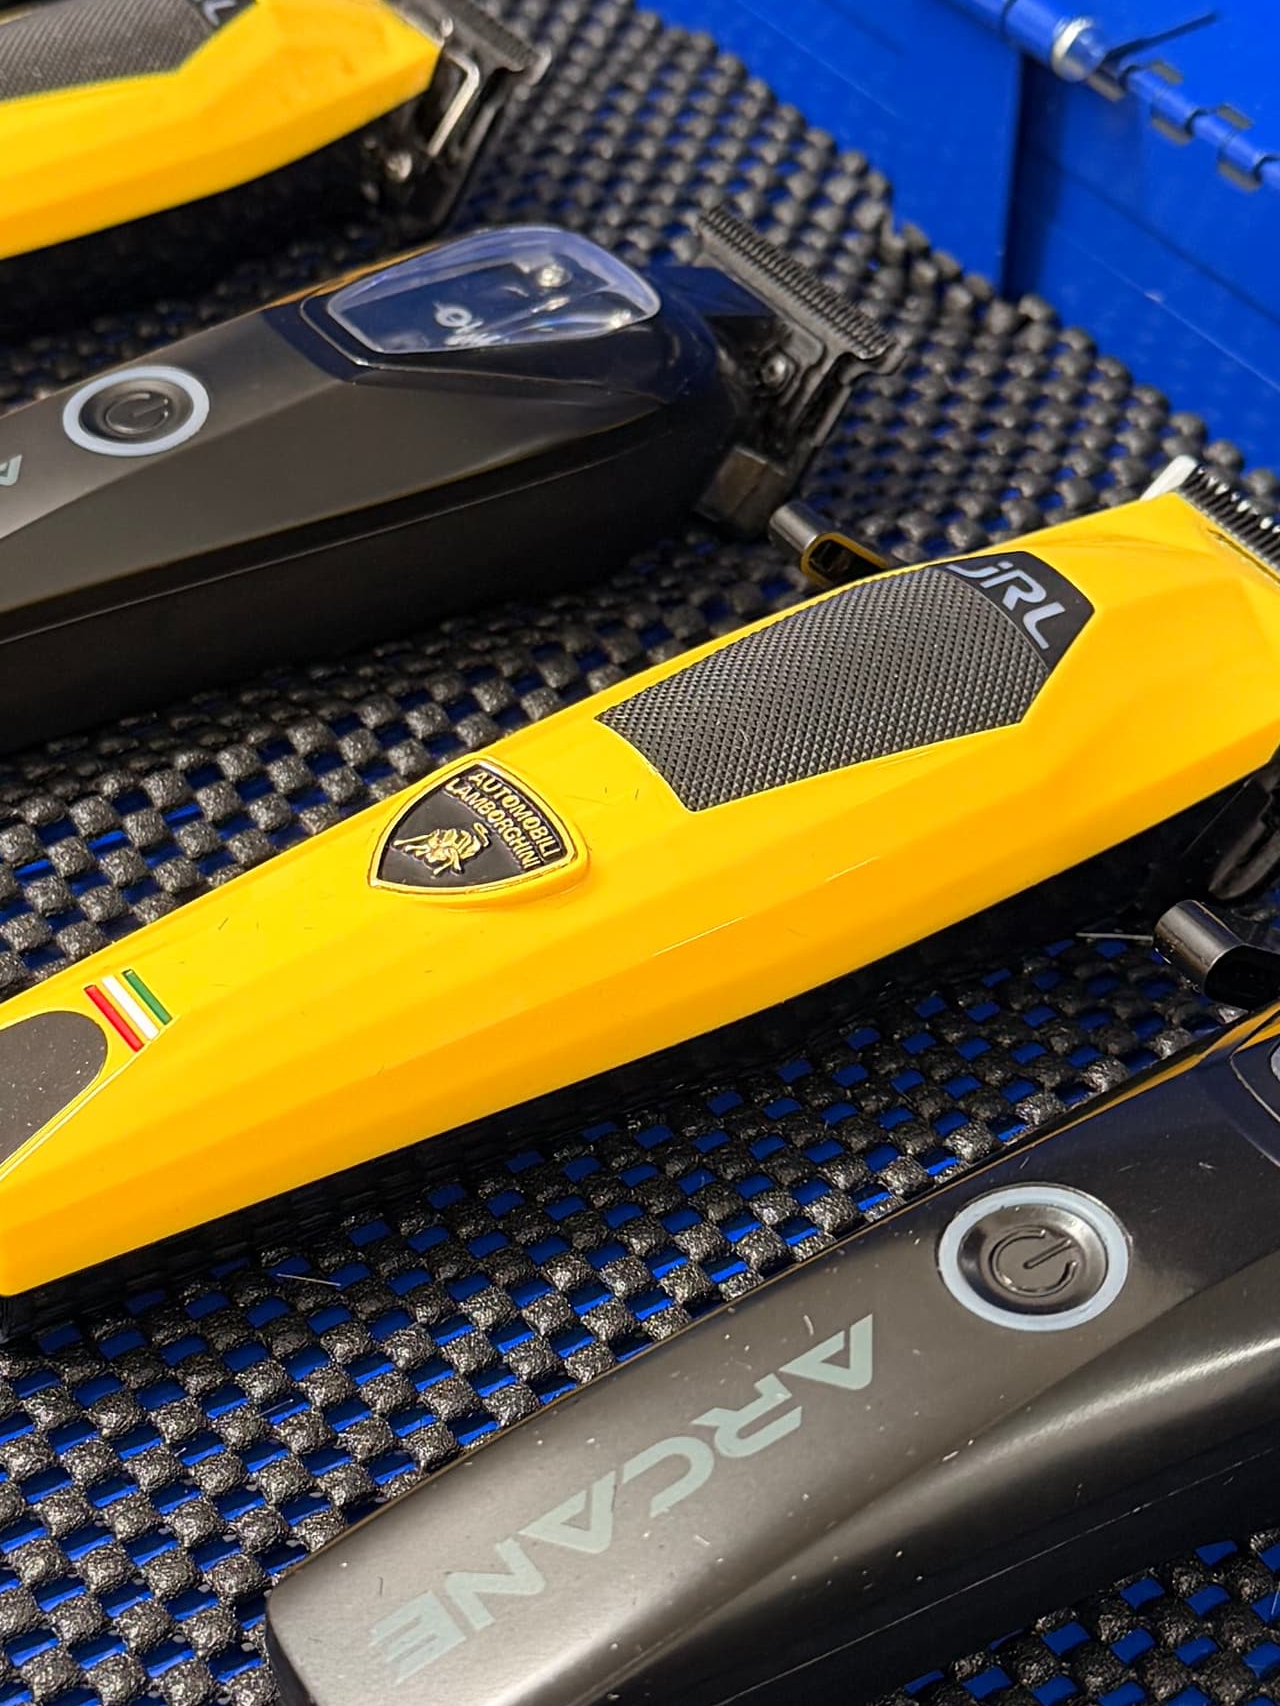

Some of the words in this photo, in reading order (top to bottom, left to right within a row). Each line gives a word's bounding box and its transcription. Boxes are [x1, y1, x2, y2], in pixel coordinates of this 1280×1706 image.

[946, 561, 1066, 650] JRL
[444, 777, 542, 870] LAMBORGHINI
[469, 770, 561, 858] AUTOMOBILI
[370, 1314, 874, 1684] ARCANE
